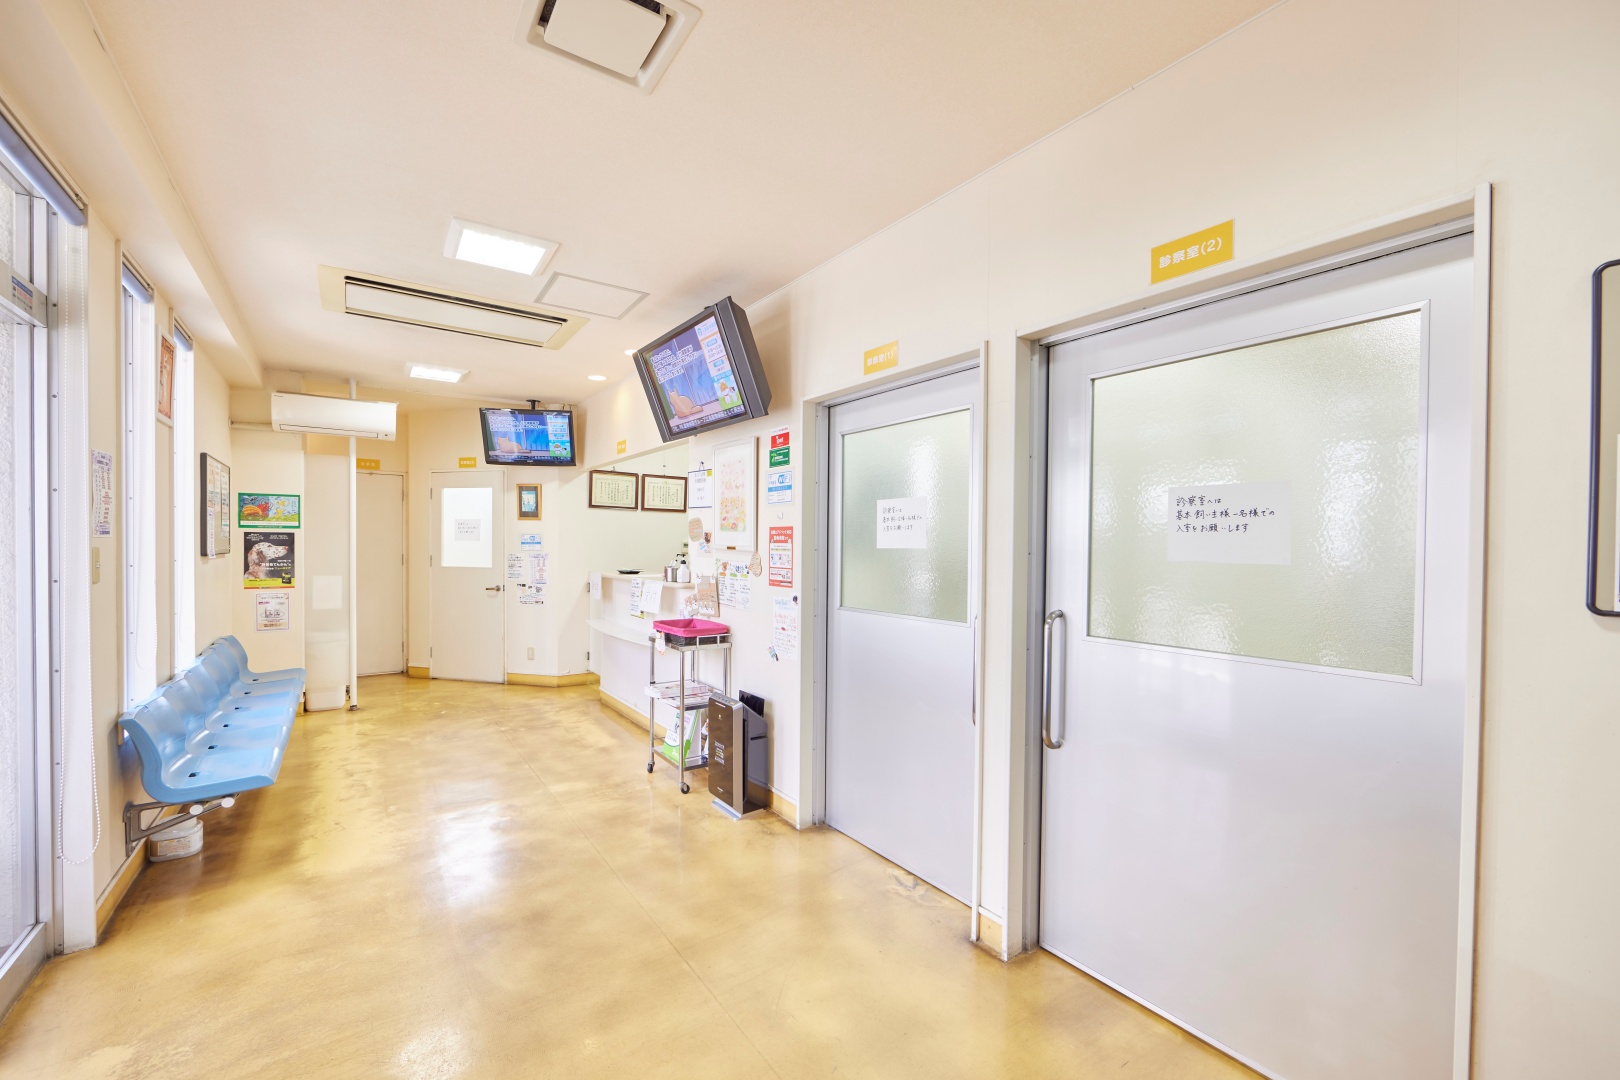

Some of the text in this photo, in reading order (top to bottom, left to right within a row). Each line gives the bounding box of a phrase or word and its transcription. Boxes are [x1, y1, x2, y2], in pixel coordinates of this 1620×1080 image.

[1159, 237, 1223, 269] 診察室(2)
[1175, 495, 1222, 507] 診察室へは
